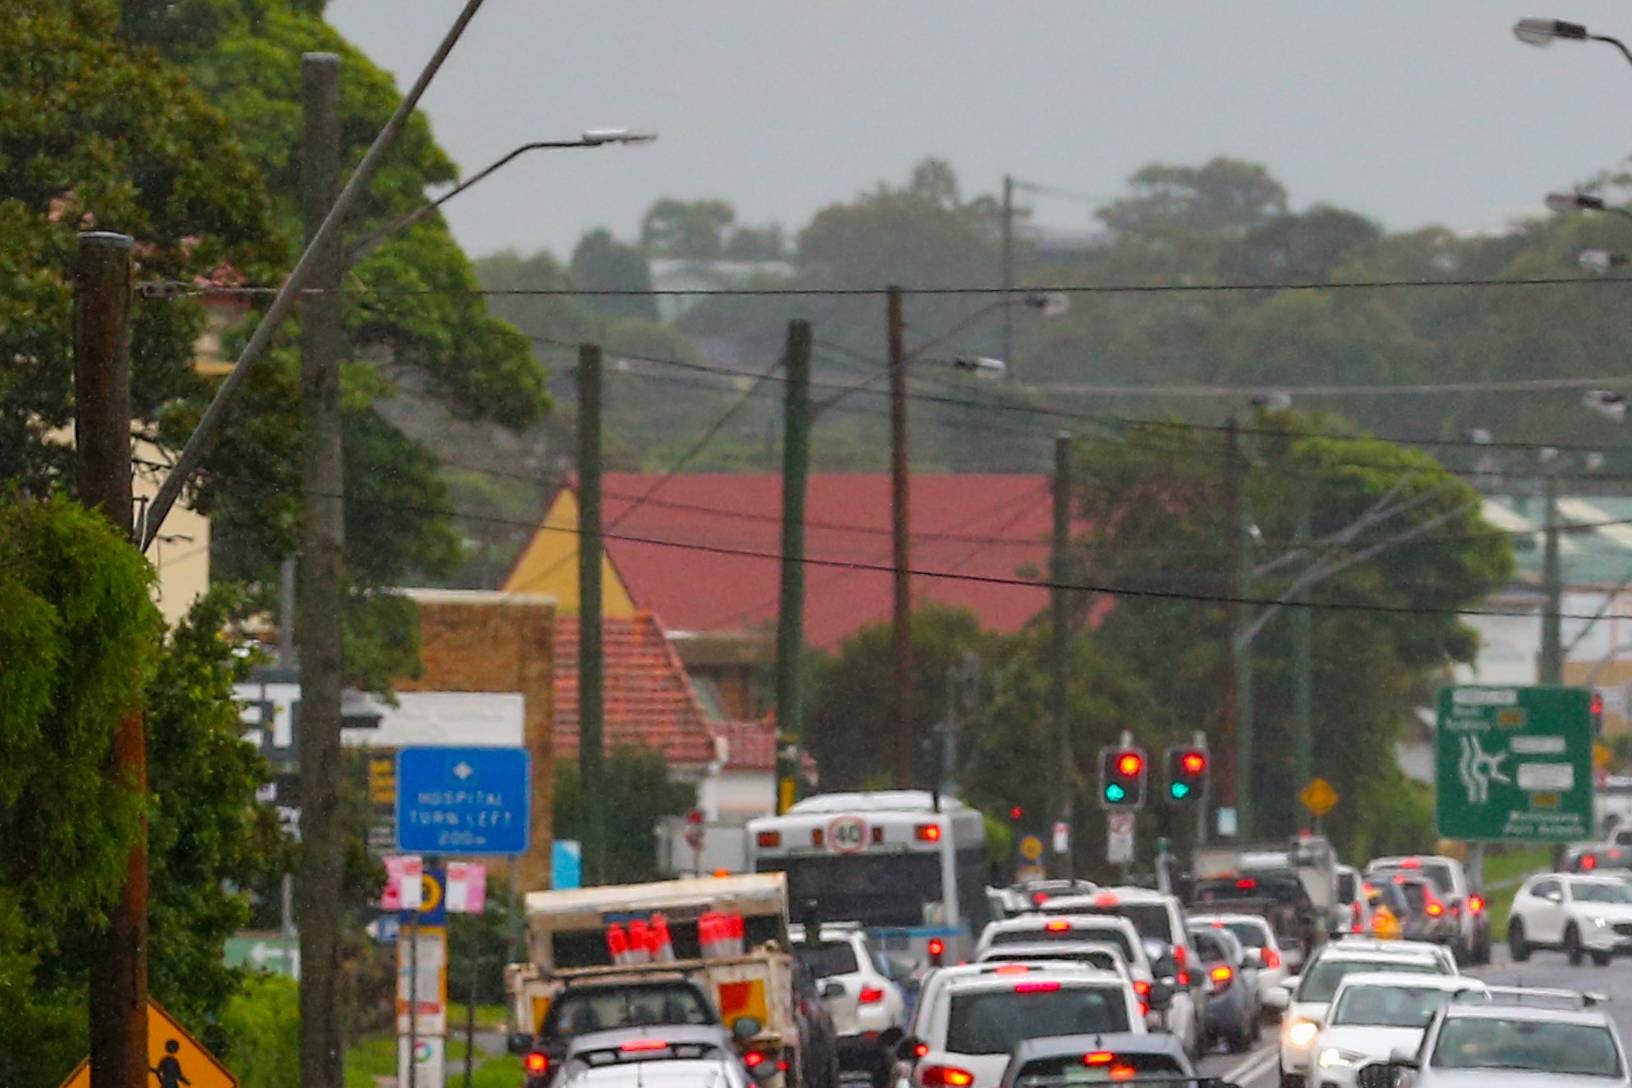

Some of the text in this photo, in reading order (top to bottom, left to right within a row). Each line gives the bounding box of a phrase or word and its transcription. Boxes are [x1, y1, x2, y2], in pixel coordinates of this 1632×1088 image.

[417, 790, 502, 807] HOSPITAL
[409, 809, 513, 828] TURN LEFT
[835, 825, 860, 843] 40
